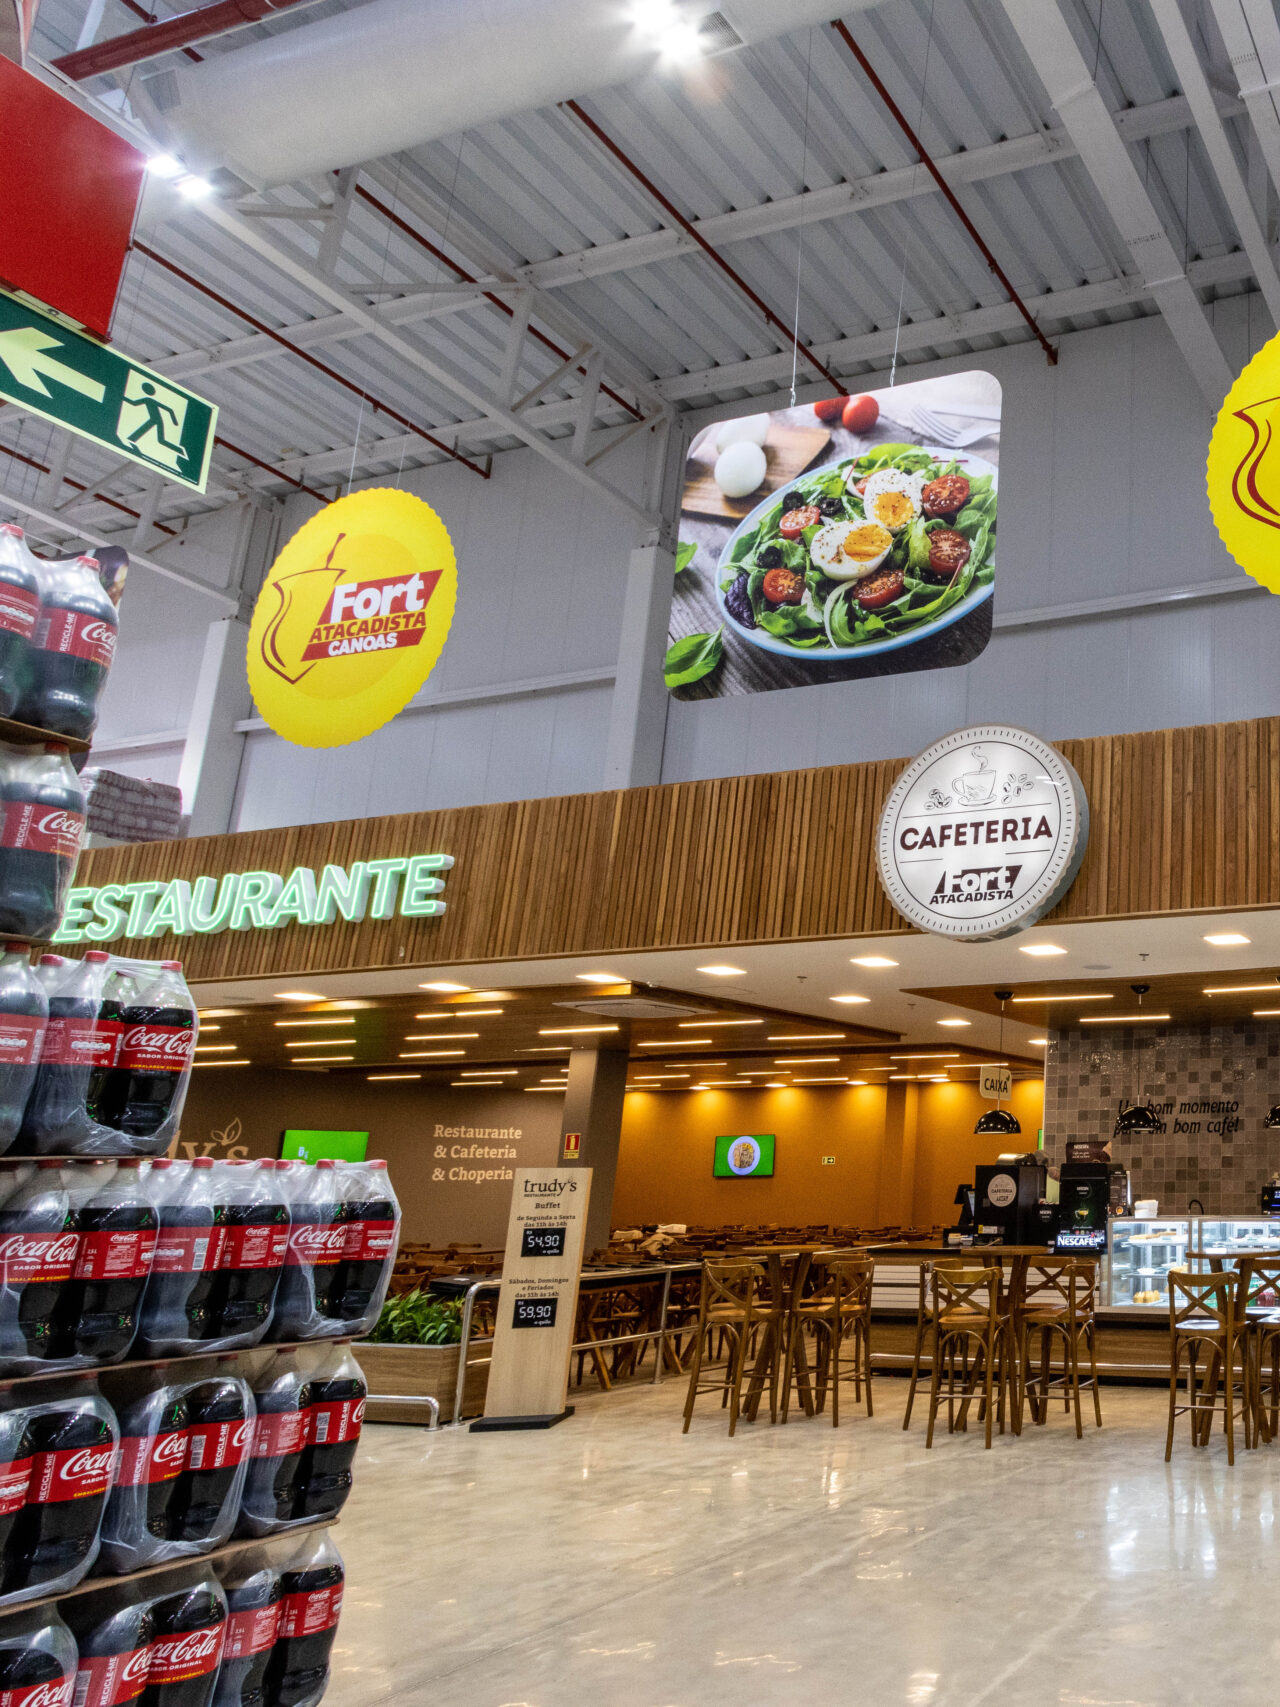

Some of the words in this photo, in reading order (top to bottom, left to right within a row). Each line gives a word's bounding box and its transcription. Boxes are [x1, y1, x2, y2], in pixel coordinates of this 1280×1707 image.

[330, 573, 424, 624] Fort
[309, 612, 426, 642] ATACADISTA
[328, 632, 398, 656] CANOAS
[900, 815, 1053, 850] CAFETERIA
[944, 866, 1012, 893] Fort
[53, 853, 454, 944] ESTAURANTE
[930, 890, 1014, 905] ATACADISTA
[122, 1027, 195, 1054] Coca-Col
[984, 1078, 1008, 1093] CAIXA
[1179, 1101, 1239, 1114] momento
[434, 1124, 523, 1140] Restaurante
[1173, 1118, 1201, 1134] bom
[1207, 1117, 1239, 1136] café!
[433, 1145, 447, 1158] &
[451, 1144, 517, 1159] Cafeteria
[432, 1167, 446, 1181] &
[449, 1166, 513, 1184] Choperia
[524, 1179, 577, 1197] trudy's
[528, 1235, 560, 1248] 54,90
[519, 1305, 552, 1319] 59,90
[214, 1424, 229, 1467] RECICLE-ME
[132, 1438, 148, 1484] RECICLE-ME
[39, 1453, 55, 1501] RECICLE-ME
[81, 1475, 106, 1485] SABOR
[150, 1624, 221, 1664] ca-Cola
[169, 1659, 202, 1670] ORIGINAL
[100, 1656, 118, 1706] RECICLE-ME
